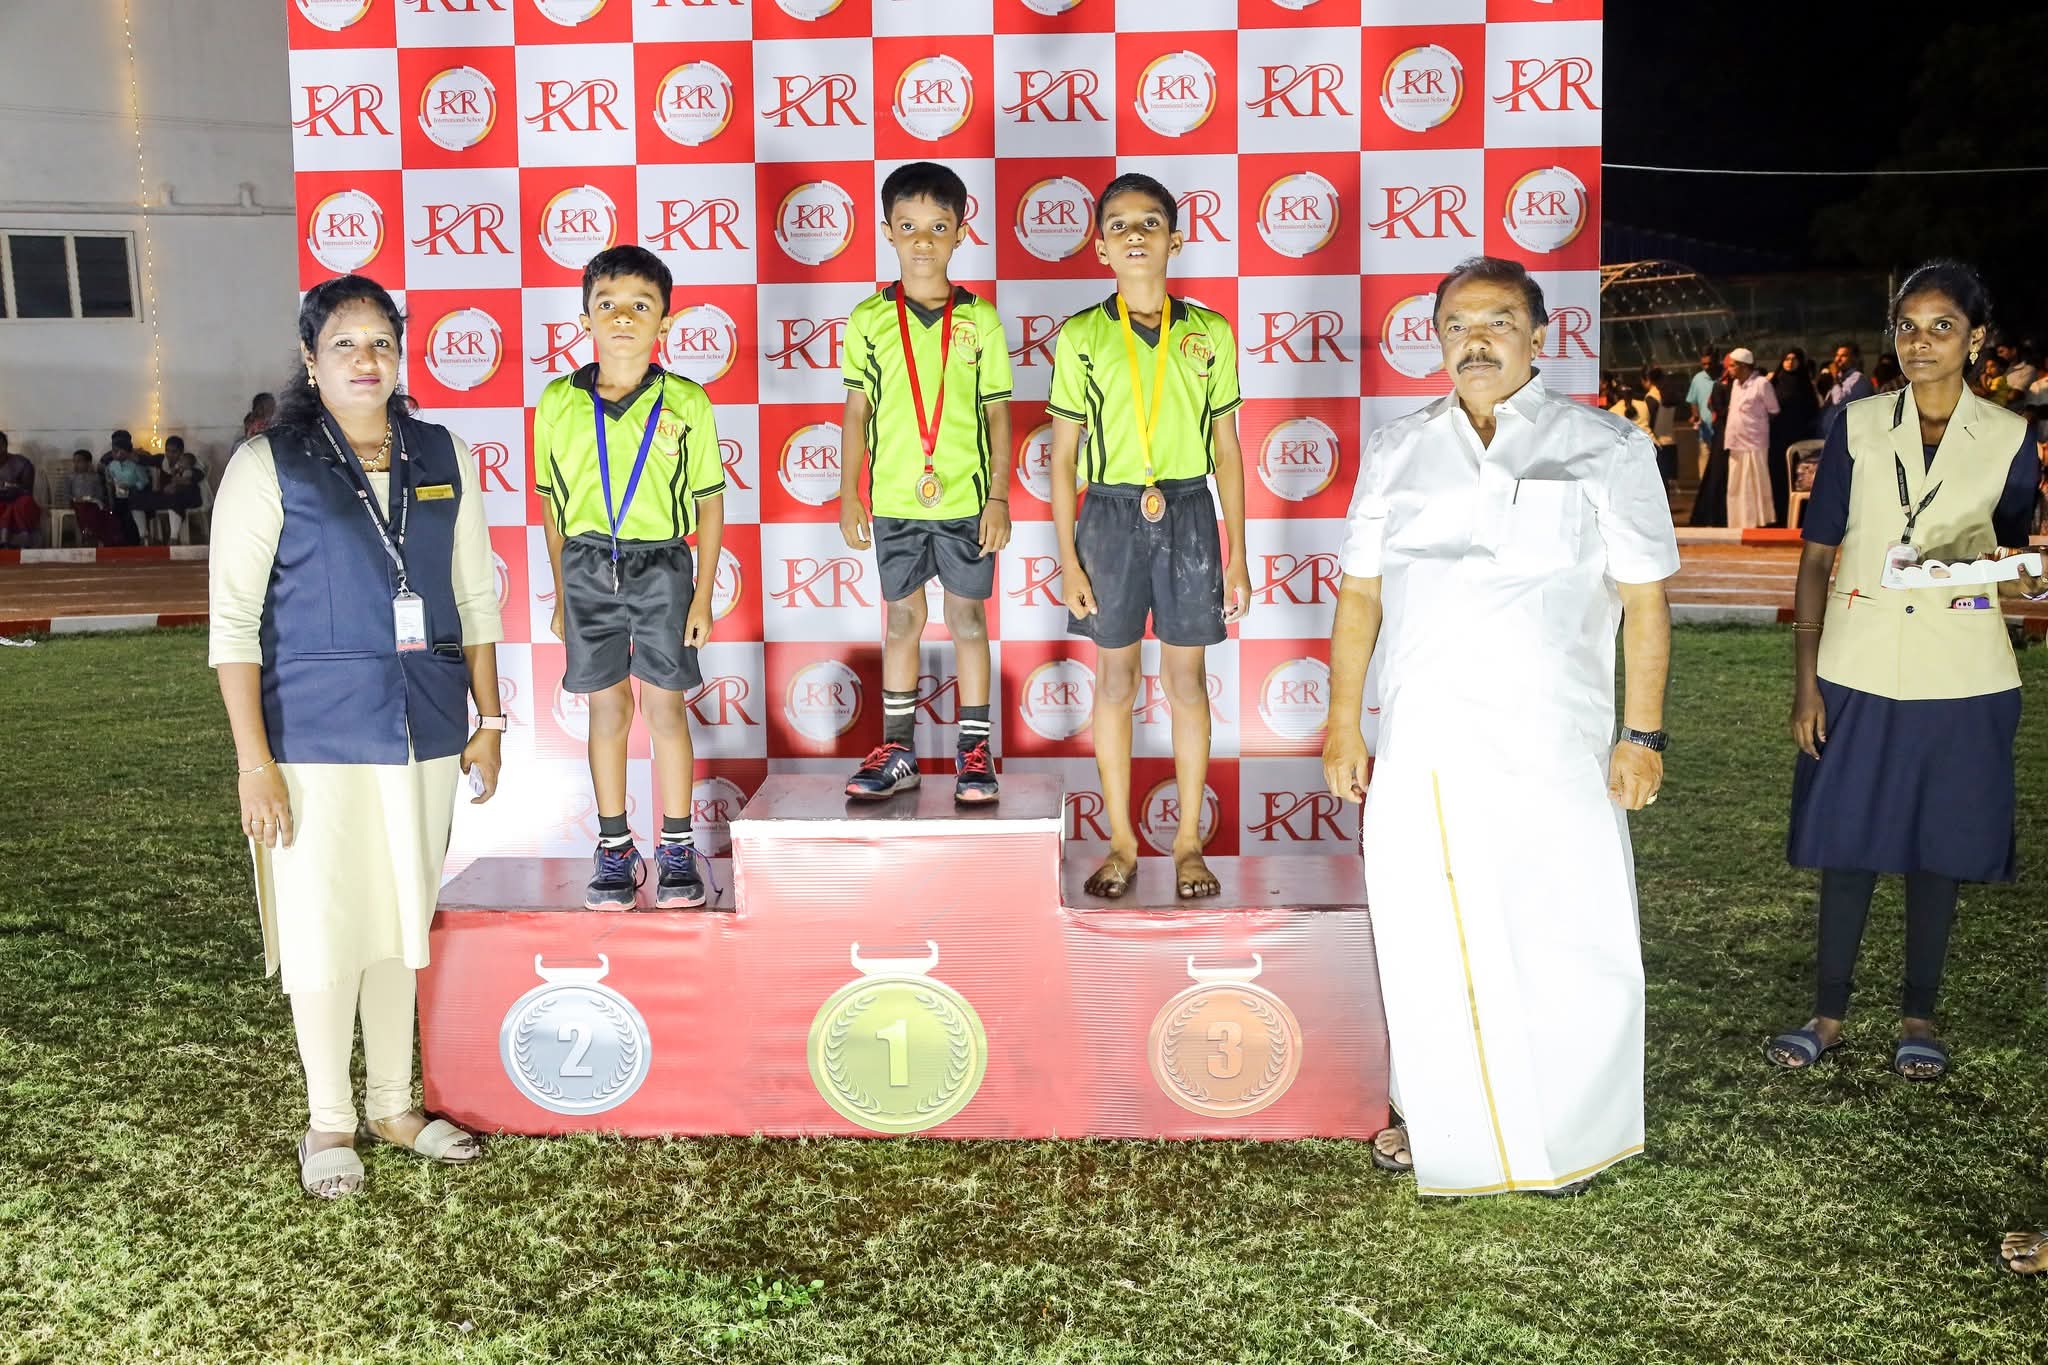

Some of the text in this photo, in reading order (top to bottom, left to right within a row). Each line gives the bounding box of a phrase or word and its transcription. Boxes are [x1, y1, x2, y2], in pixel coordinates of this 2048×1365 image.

[1064, 226, 1082, 234] School
[440, 356, 490, 364] International School
[556, 1022, 593, 1078] 2
[873, 1019, 908, 1087] 1
[1207, 1022, 1244, 1078] 3
